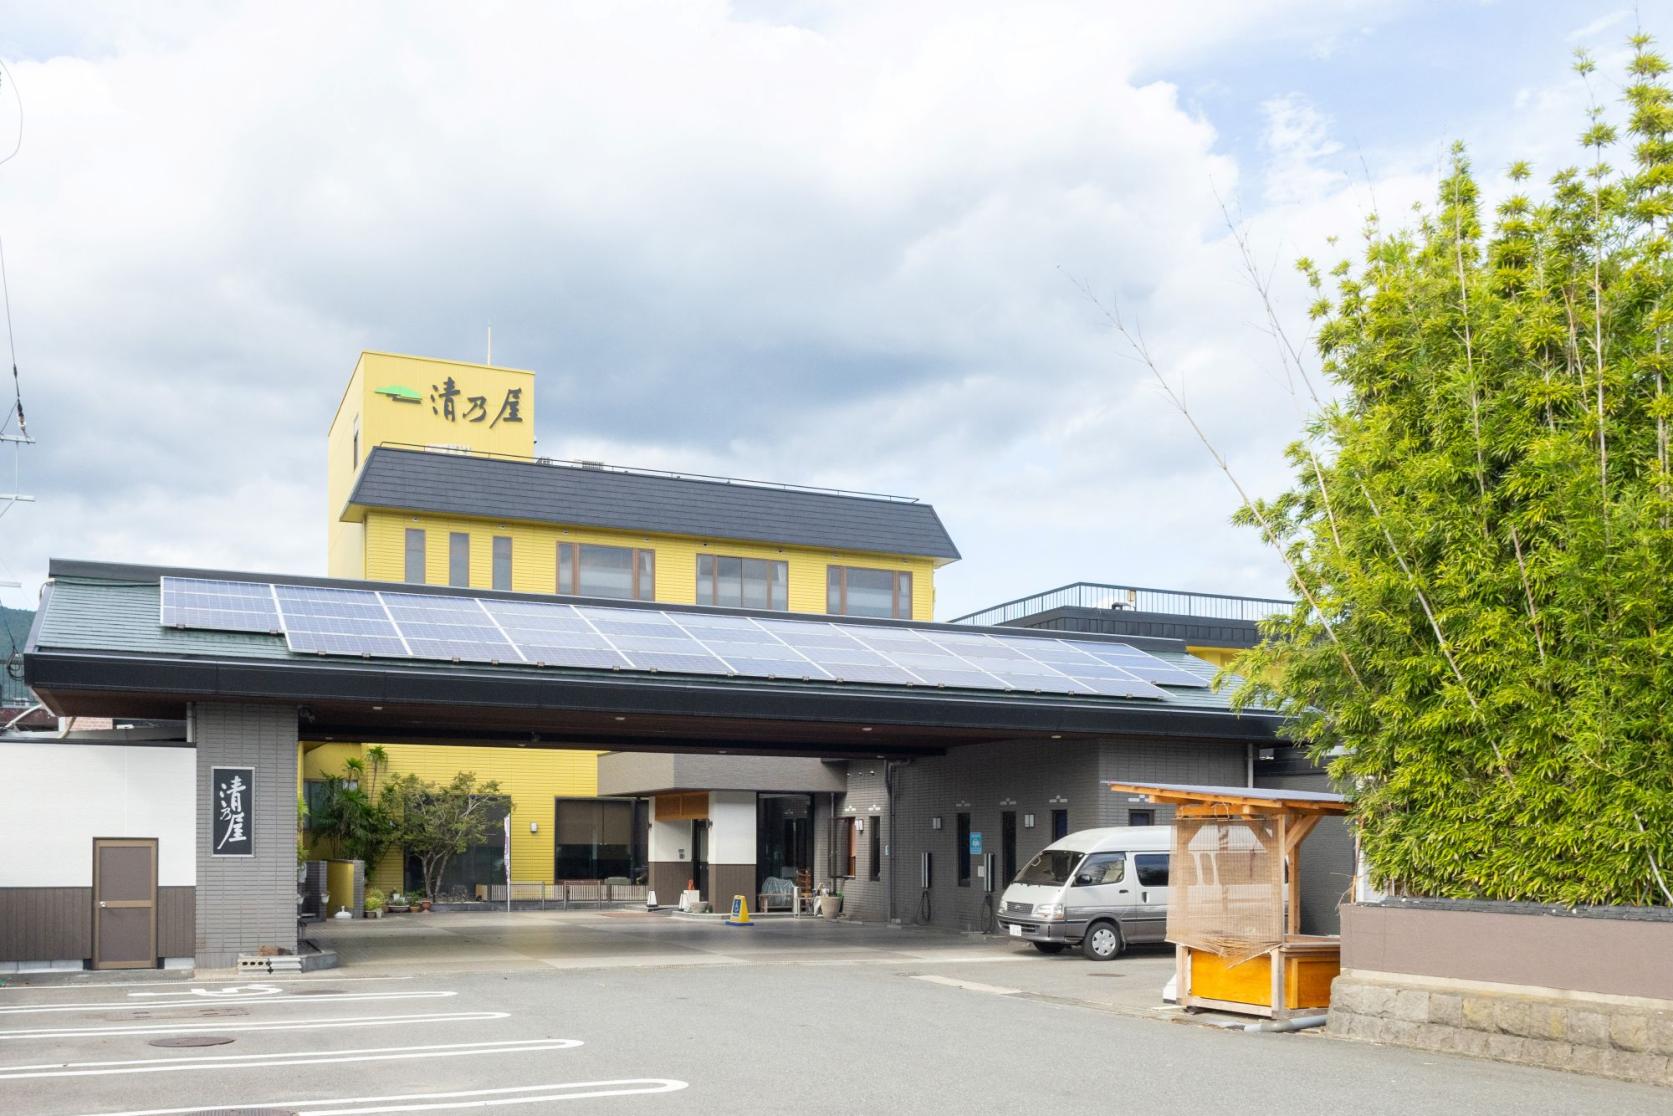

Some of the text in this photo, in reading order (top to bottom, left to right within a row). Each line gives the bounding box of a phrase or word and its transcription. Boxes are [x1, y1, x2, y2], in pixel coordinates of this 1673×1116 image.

[430, 376, 523, 429] 清乃屋
[217, 775, 247, 849] 清乃屋
